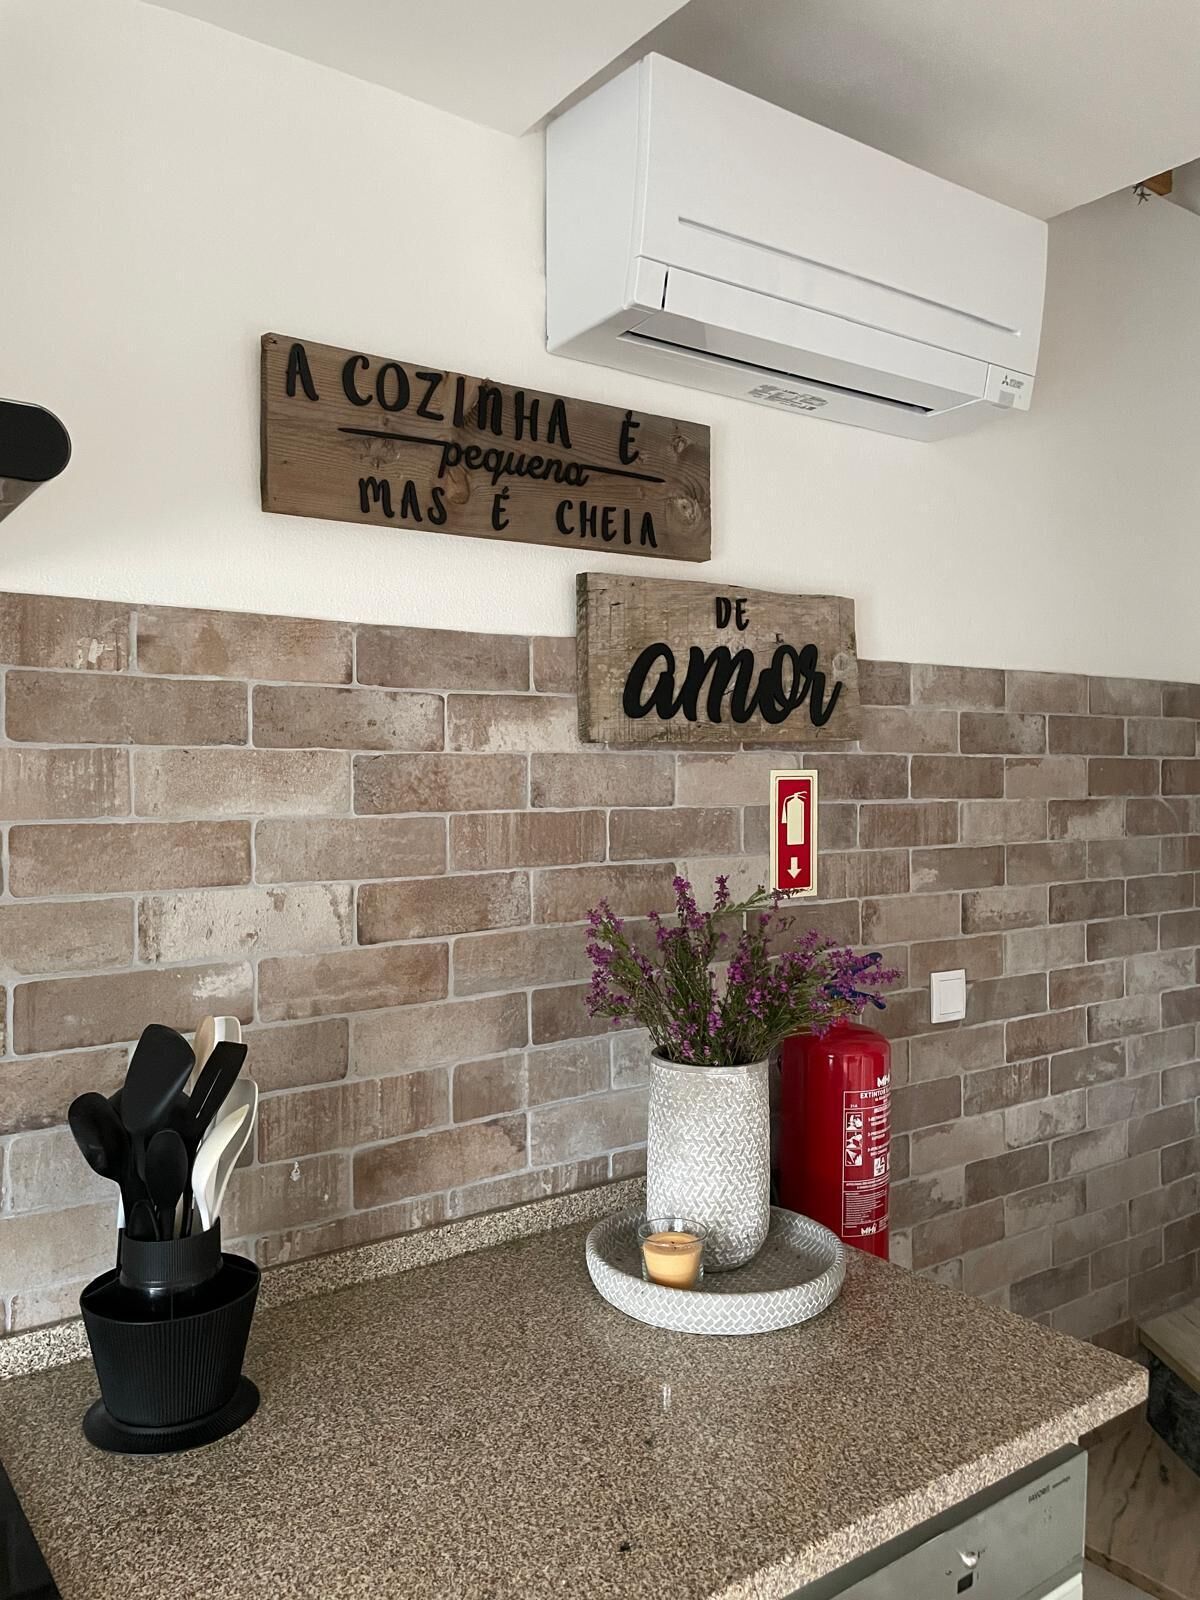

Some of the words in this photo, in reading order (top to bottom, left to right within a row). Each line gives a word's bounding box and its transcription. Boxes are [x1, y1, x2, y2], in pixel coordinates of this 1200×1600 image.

[285, 342, 319, 401] A
[342, 354, 572, 450] COZINHA
[438, 440, 592, 487] pequena
[357, 476, 448, 526] MAS
[491, 486, 510, 531] É
[554, 499, 658, 548] CHEIA
[715, 596, 750, 631] DE
[622, 642, 843, 727] amor
